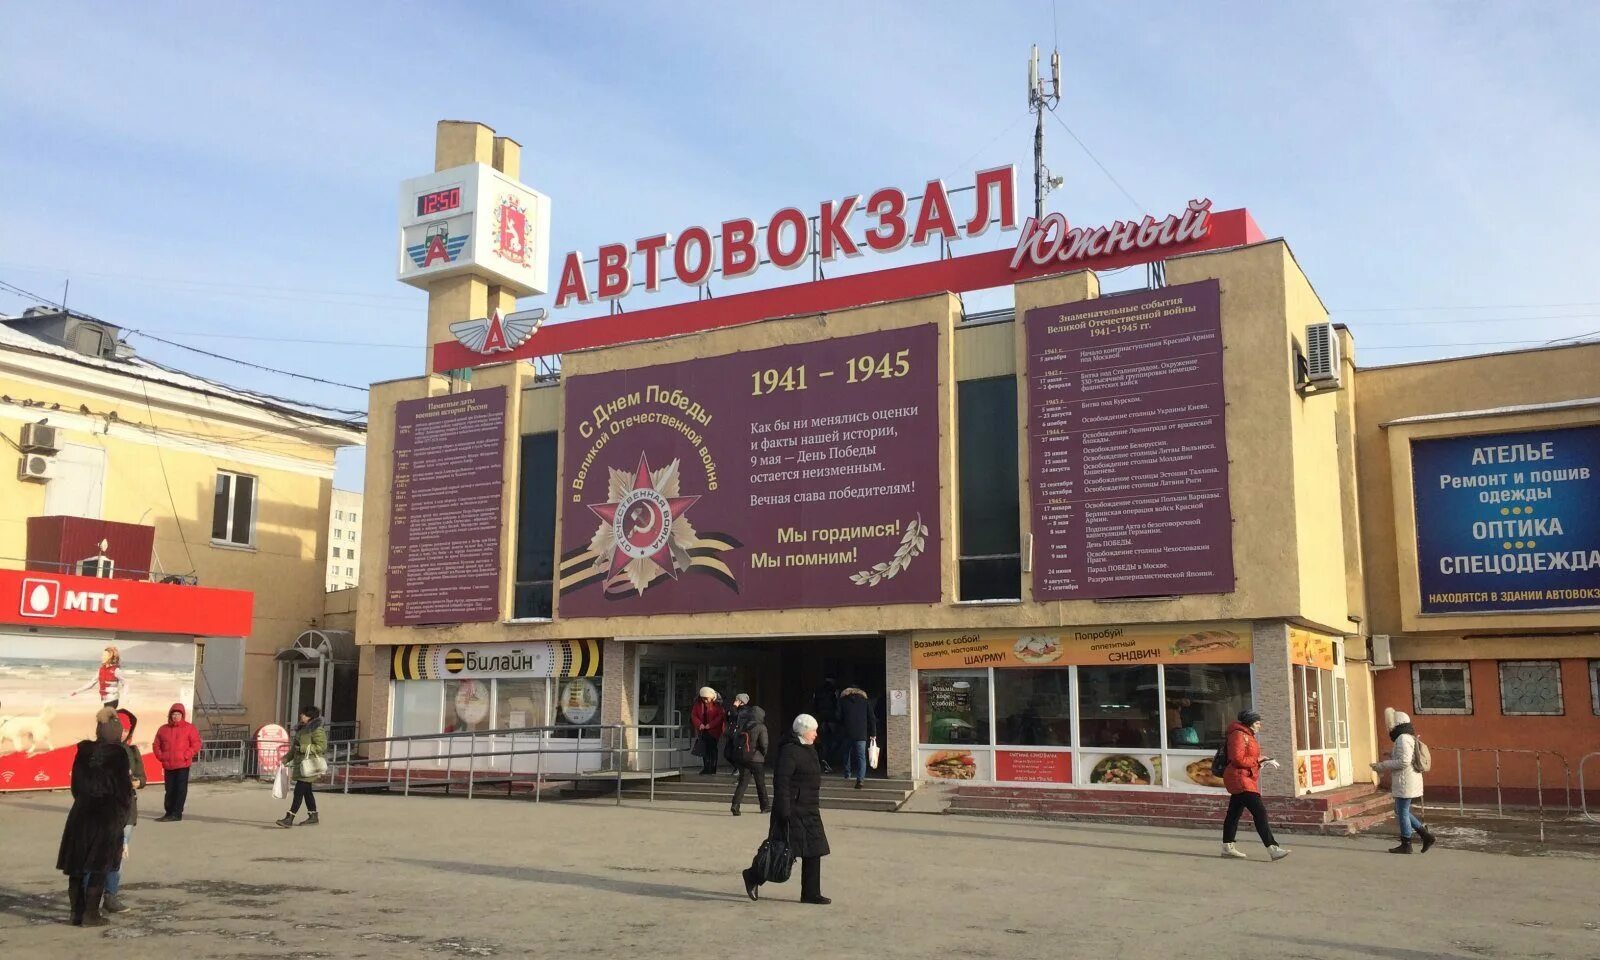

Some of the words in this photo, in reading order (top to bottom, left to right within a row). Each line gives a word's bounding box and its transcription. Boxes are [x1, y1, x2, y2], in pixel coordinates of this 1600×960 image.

[423, 187, 460, 214] 12:50
[553, 163, 1017, 308] АВТОВОКЗАЛ
[1009, 198, 1212, 272] Южный
[424, 235, 451, 268] А
[1047, 321, 1086, 334] Великой
[1088, 309, 1161, 327] Отечественной
[1163, 305, 1196, 316] войны
[1058, 305, 1138, 323] Знаменательные
[1140, 297, 1183, 310] события
[480, 307, 513, 355] А
[1090, 322, 1137, 337] 1941–1945
[1140, 322, 1151, 330] гг.
[751, 364, 808, 396] 1941
[846, 348, 910, 384] 1945
[579, 420, 593, 439] С
[593, 391, 641, 430] Днем
[646, 384, 713, 428] Победы
[750, 422, 772, 435] Как
[774, 419, 790, 432] бы
[793, 419, 808, 430] ни
[811, 412, 869, 428] менялись
[872, 405, 919, 421] оценки
[609, 412, 701, 448] Отечественной
[750, 440, 758, 451] и
[760, 435, 798, 452] факты
[800, 430, 840, 446] нашей
[842, 425, 898, 440] истории,
[572, 430, 611, 491] Великой
[750, 455, 757, 468] 9
[760, 455, 782, 467] мая
[796, 450, 827, 464] День
[829, 444, 877, 460] Победы
[1471, 442, 1555, 466] АТЕЛЬЕ
[698, 446, 718, 491] войне
[750, 469, 800, 484] остается
[802, 462, 886, 479] неизменным.
[1440, 473, 1508, 489] Ремонт
[1513, 473, 1524, 483] и
[1530, 467, 1591, 482] пошив
[572, 494, 581, 503] в
[750, 493, 791, 507] Вечная
[793, 490, 826, 503] слава
[829, 481, 915, 500] победителям!
[1479, 487, 1552, 504] одежды
[615, 490, 667, 553] ОТЕЧЕСТВЕННАЯ
[777, 526, 807, 544] Мы
[812, 519, 900, 545] гордимся!
[1472, 517, 1564, 540] ОПТИКА
[751, 552, 781, 569] Мы
[785, 546, 858, 567] помним!
[1439, 550, 1600, 575] СПЕЦОДЕЖДА
[63, 590, 119, 614] МТС
[1429, 592, 1488, 604] НАХОДЯТСЯ
[1491, 591, 1498, 602] В
[1500, 590, 1543, 602] ЗДАНИИ
[914, 639, 944, 649] Возьми
[953, 634, 980, 645] собой!
[1074, 628, 1124, 641] Попробуй!
[1090, 640, 1136, 651] аппетитный
[466, 649, 533, 671] Билайн
[923, 649, 949, 658] свежую,
[951, 644, 989, 655] настоящую
[964, 652, 1006, 665] ШАУРМУ!
[1108, 648, 1161, 662] СЭНДВИЧ!
